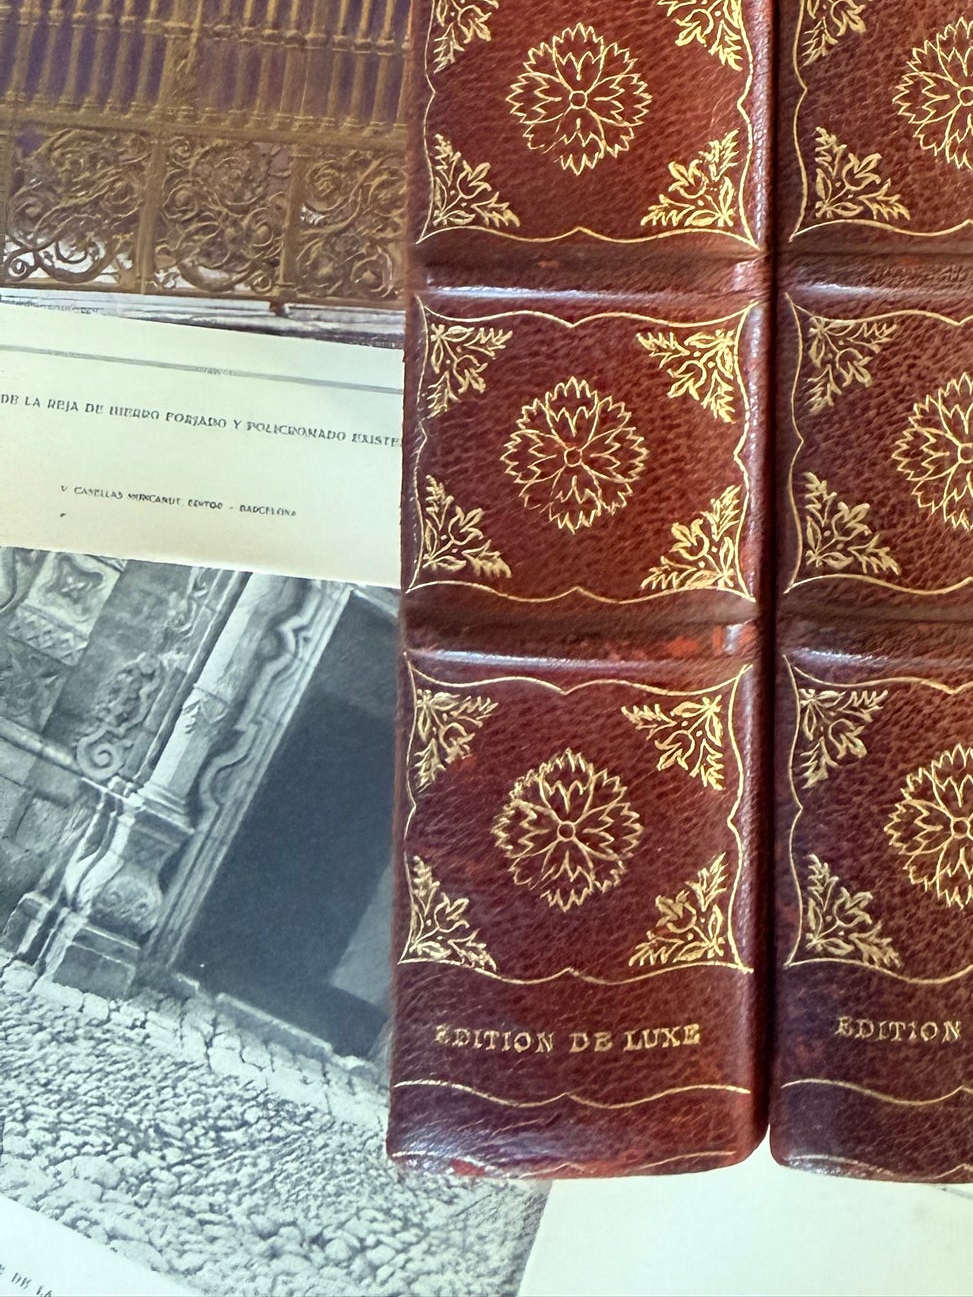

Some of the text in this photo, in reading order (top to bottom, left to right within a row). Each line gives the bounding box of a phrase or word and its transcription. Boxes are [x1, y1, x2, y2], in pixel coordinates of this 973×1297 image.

[1, 393, 19, 405] DE
[24, 396, 41, 408] LA
[47, 399, 79, 412] REJA
[85, 403, 104, 415] DE
[233, 419, 243, 431] Y
[351, 433, 403, 447] EXISTE
[434, 1023, 700, 1053] EDITION DE LUXE
[834, 1015, 961, 1043] EDITION
